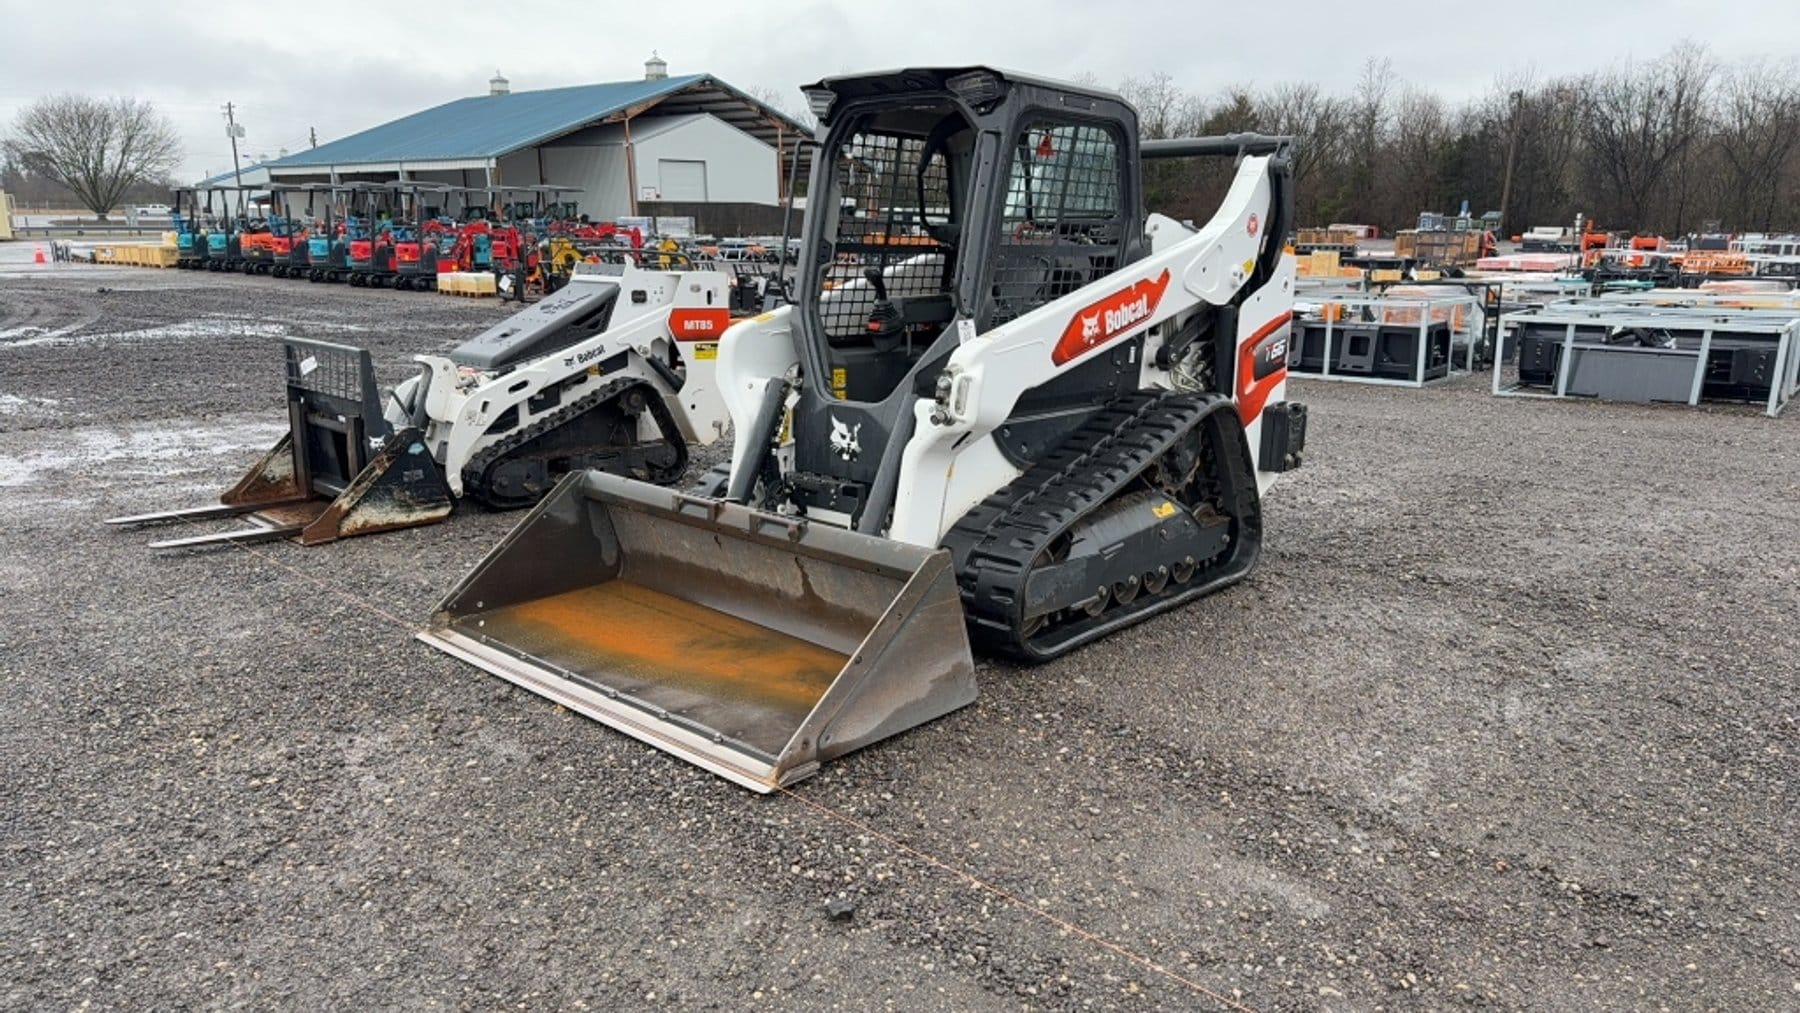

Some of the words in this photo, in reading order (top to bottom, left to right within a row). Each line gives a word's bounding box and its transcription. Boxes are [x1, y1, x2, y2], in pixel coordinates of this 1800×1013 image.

[1104, 293, 1148, 335] Bobcat
[684, 319, 713, 330] MT85
[576, 344, 606, 364] Bobcat
